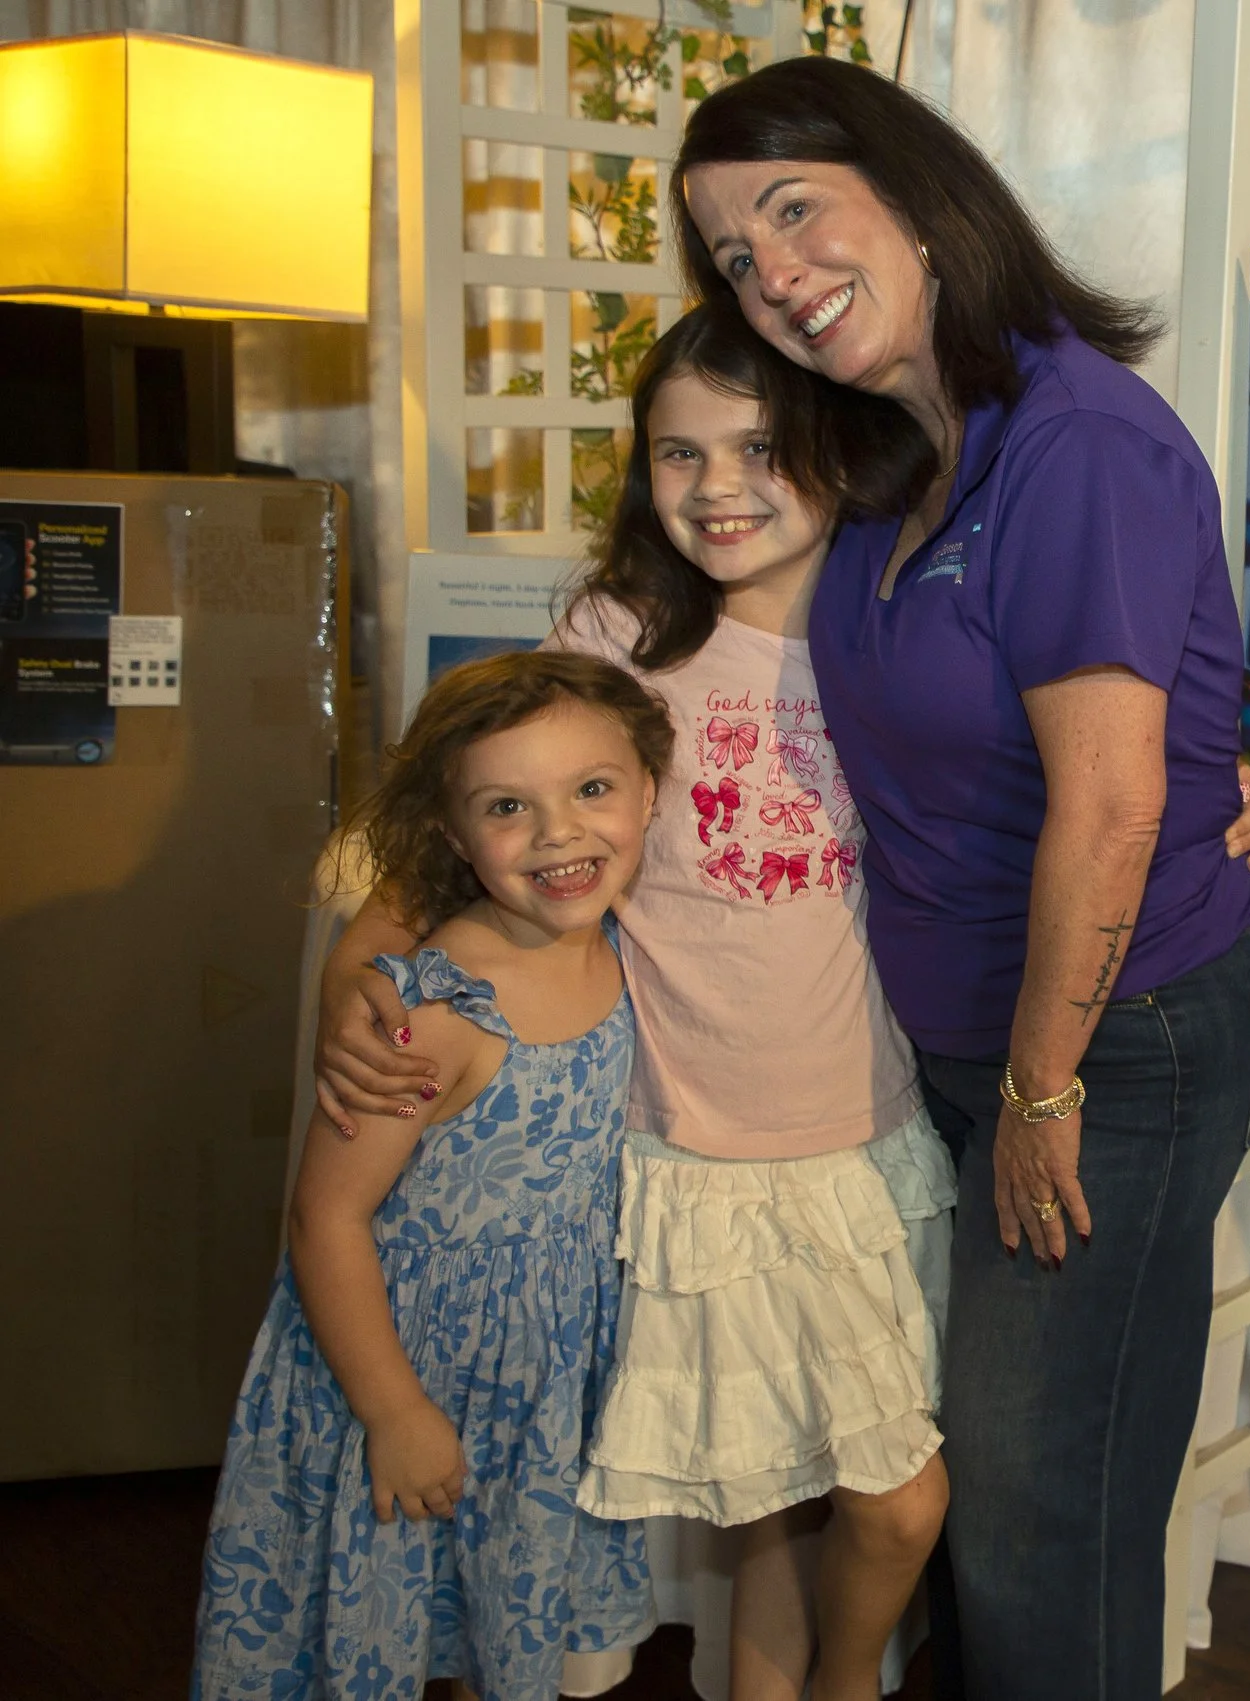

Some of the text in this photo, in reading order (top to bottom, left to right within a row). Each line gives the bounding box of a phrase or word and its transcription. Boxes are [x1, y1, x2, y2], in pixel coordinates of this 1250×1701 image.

[82, 535, 106, 547] App
[707, 689, 821, 725] God says
[788, 727, 821, 737] valued
[762, 791, 786, 801] loved
